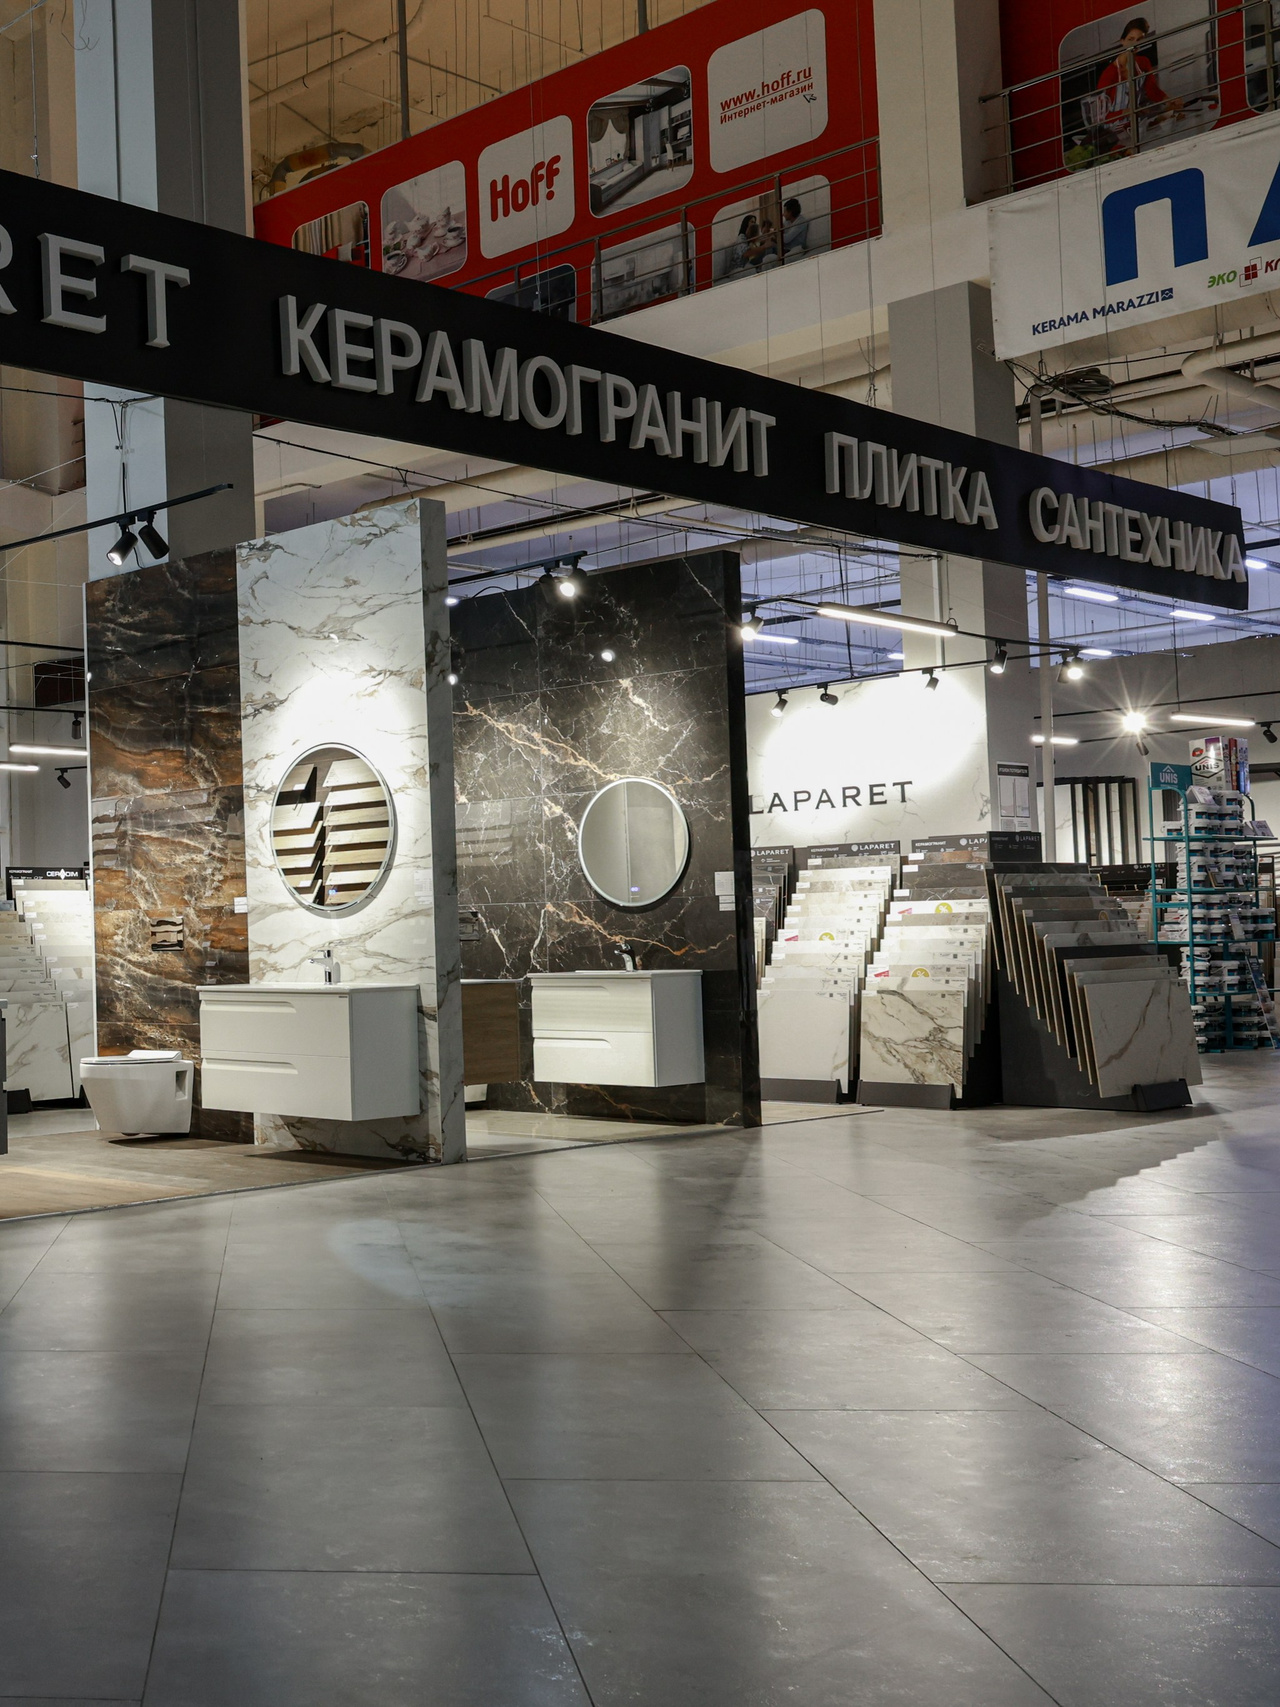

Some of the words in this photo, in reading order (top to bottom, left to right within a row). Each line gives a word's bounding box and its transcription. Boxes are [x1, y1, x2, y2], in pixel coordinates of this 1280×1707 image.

[719, 66, 813, 112] www.hoff.ru
[719, 81, 814, 125] Интернет-магазин
[1032, 311, 1090, 336] KERAMA
[1092, 291, 1160, 320] MARAZZI
[278, 294, 777, 477] КЕРАМОГРАНИТ
[824, 431, 999, 531] ПЛИТКА
[1028, 486, 1248, 583] САНТЕХНИКА
[1159, 772, 1179, 784] UNIS
[1194, 761, 1221, 772] UNIS
[748, 781, 913, 815] LAPARET
[756, 849, 790, 857] LAPARET
[859, 843, 895, 851] LAPARET
